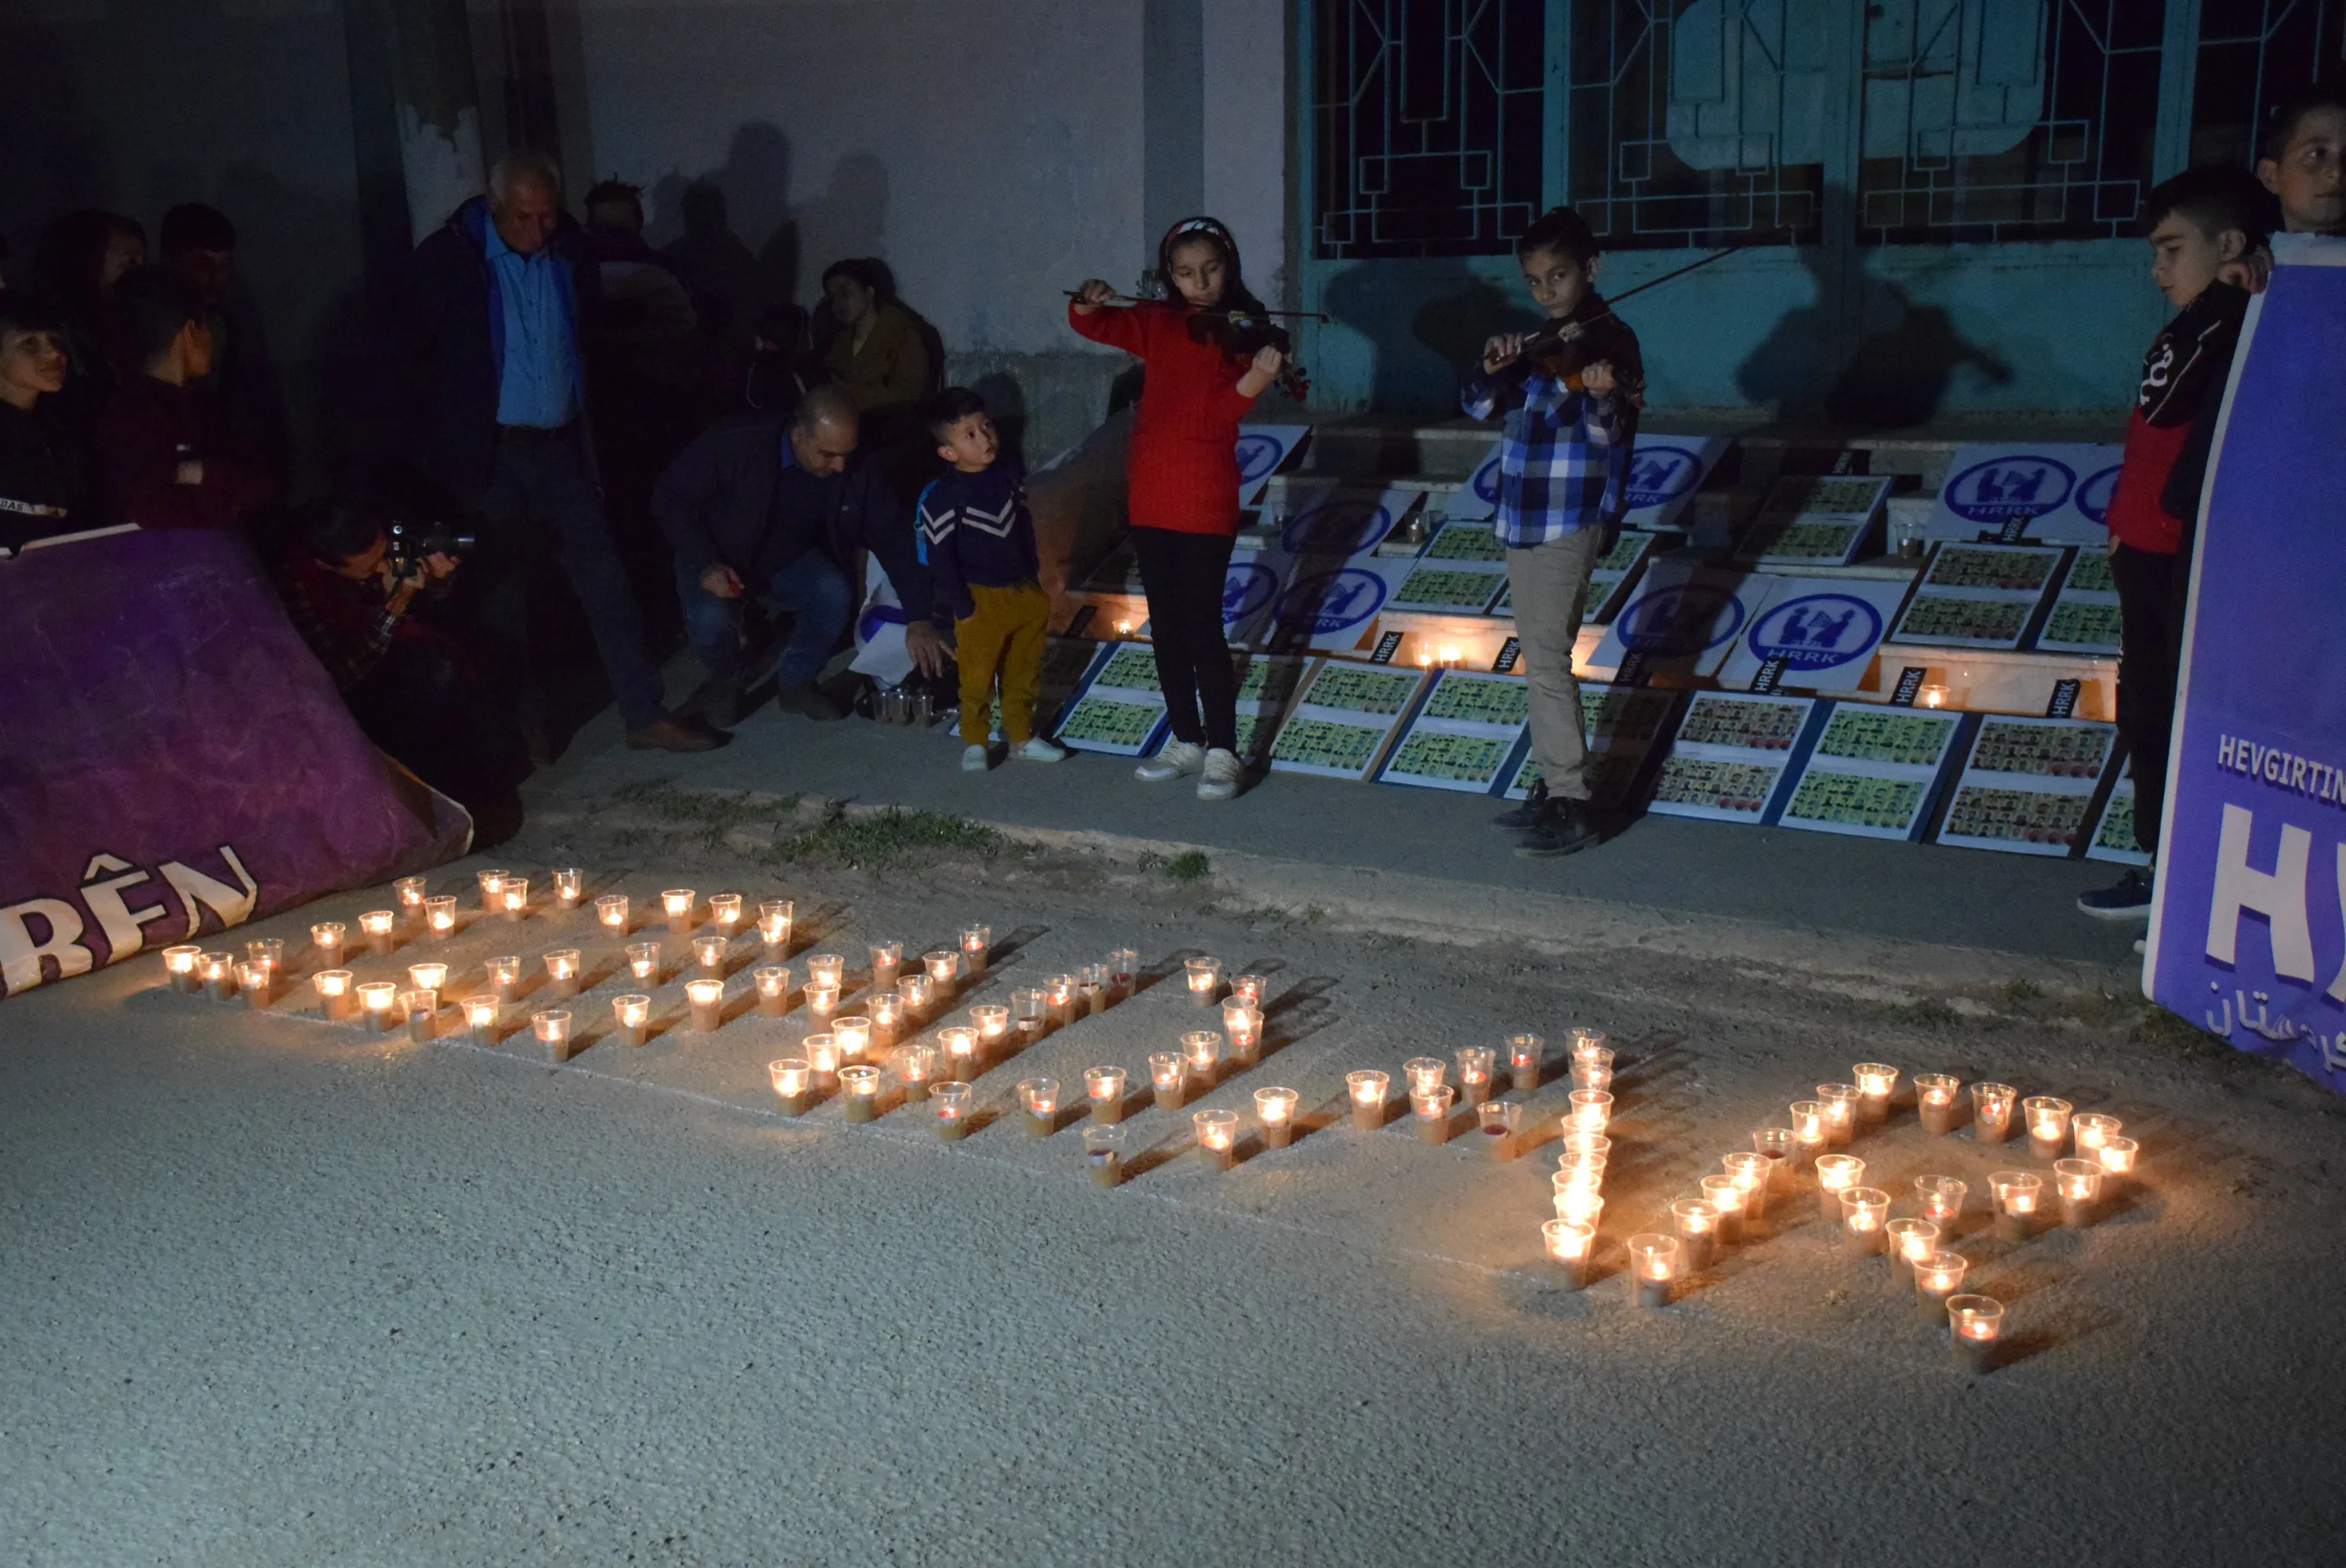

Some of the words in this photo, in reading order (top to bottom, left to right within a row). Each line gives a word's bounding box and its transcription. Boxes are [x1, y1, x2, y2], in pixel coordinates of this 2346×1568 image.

[1374, 633, 1400, 662] HRRK
[1498, 639, 1520, 669] HRRK
[1767, 648, 1839, 664] HRRK
[1618, 652, 1644, 683] HRRK
[1753, 659, 1780, 691] HRRK
[1895, 670, 1922, 703] HRRK
[2053, 681, 2077, 717] HRRK
[2217, 734, 2346, 804] HEVGIRTIN
